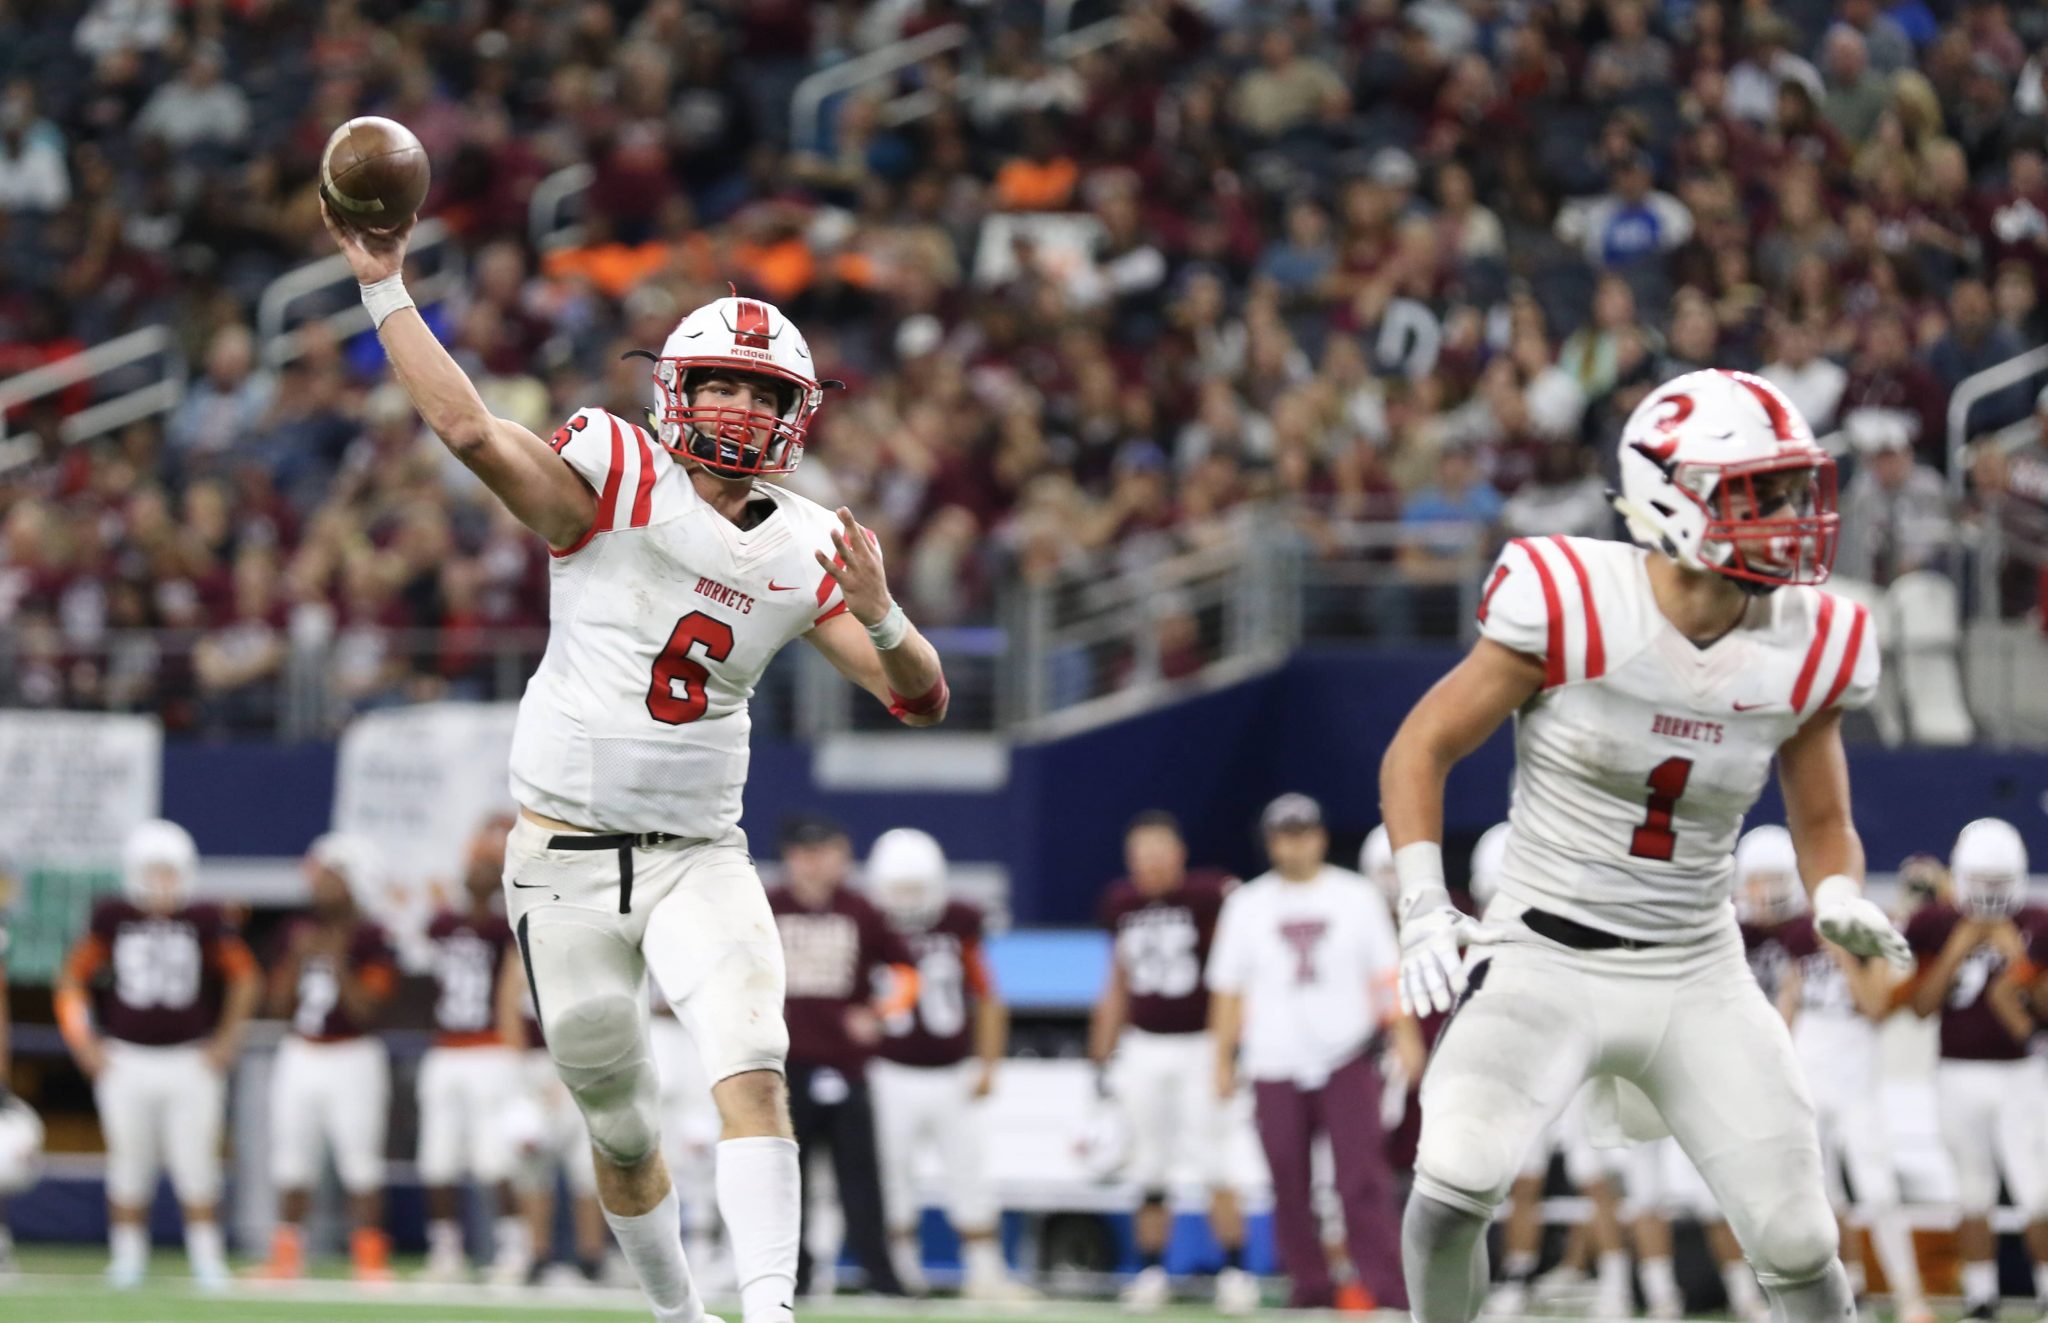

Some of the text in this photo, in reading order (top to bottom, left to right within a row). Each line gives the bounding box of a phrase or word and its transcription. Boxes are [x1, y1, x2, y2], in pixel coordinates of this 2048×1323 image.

[730, 347, 774, 361] Riddell
[694, 576, 756, 615] HORNETS
[645, 609, 735, 726] 6
[1650, 713, 1725, 744] HORNETS
[1628, 755, 1695, 862] 1
